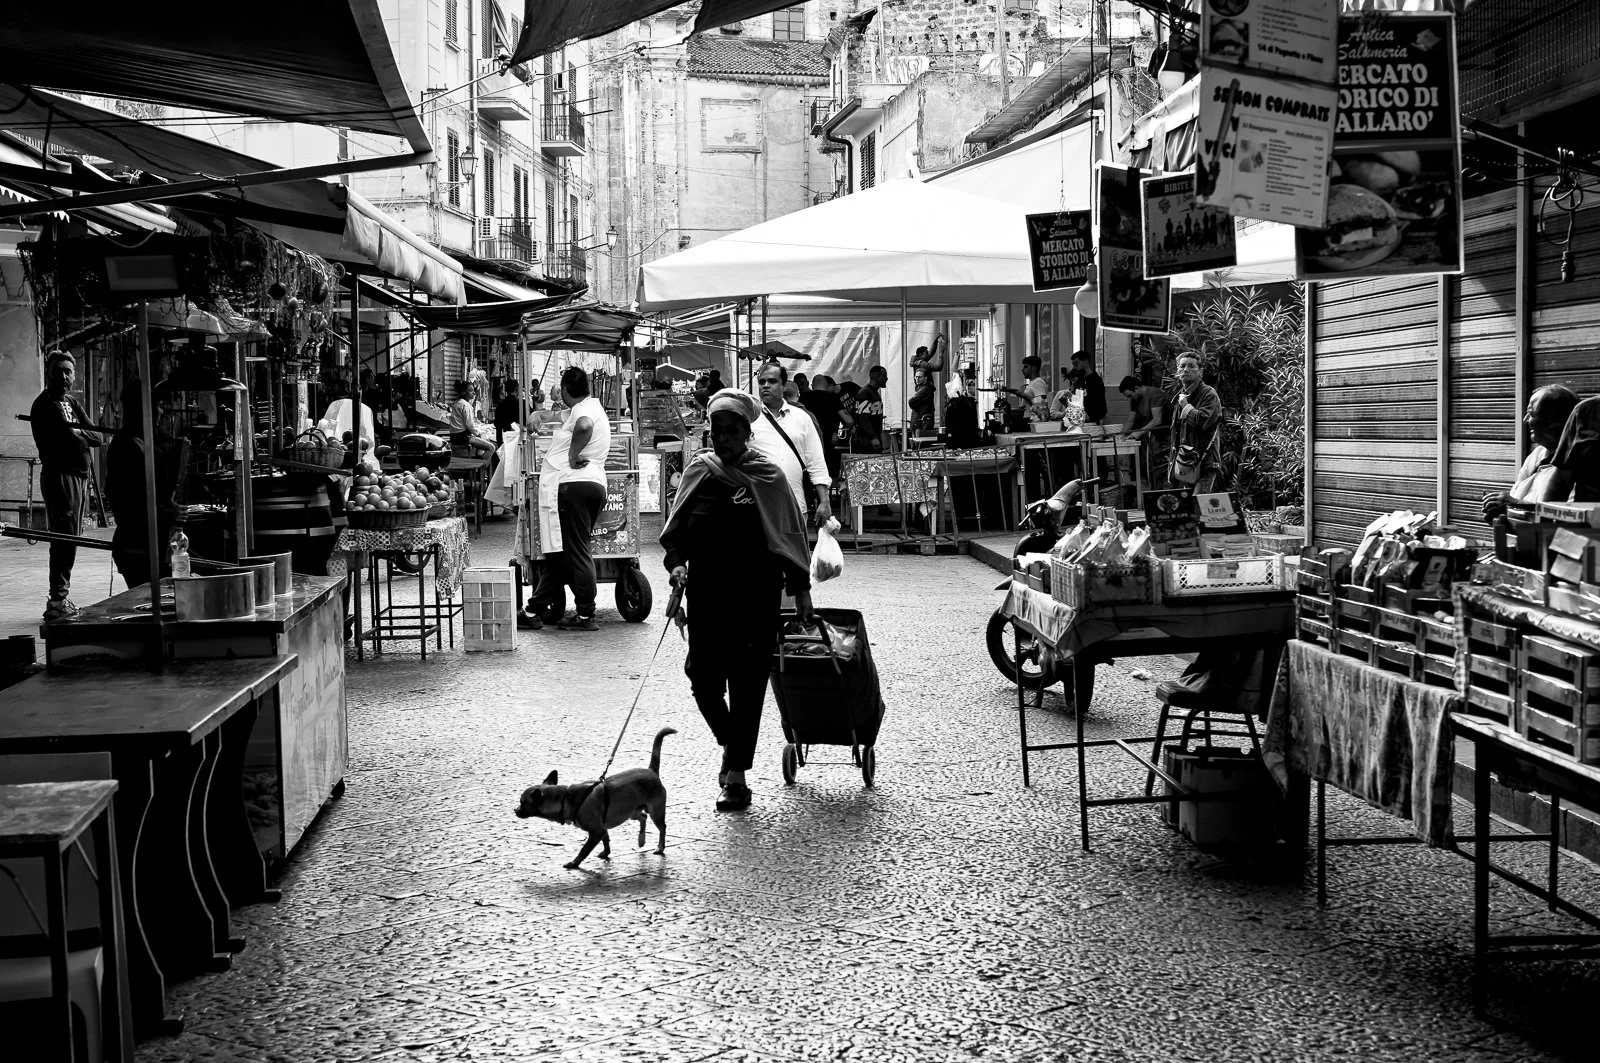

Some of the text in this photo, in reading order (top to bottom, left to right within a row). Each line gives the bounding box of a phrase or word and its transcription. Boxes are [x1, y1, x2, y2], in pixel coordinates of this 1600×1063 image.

[1338, 43, 1409, 60] Salumeria
[1414, 86, 1439, 107] DI
[1265, 95, 1330, 122] COMPRATE
[1042, 238, 1085, 253] MERCATO
[1039, 251, 1089, 268] STORICO DI
[606, 493, 623, 502] ONE
